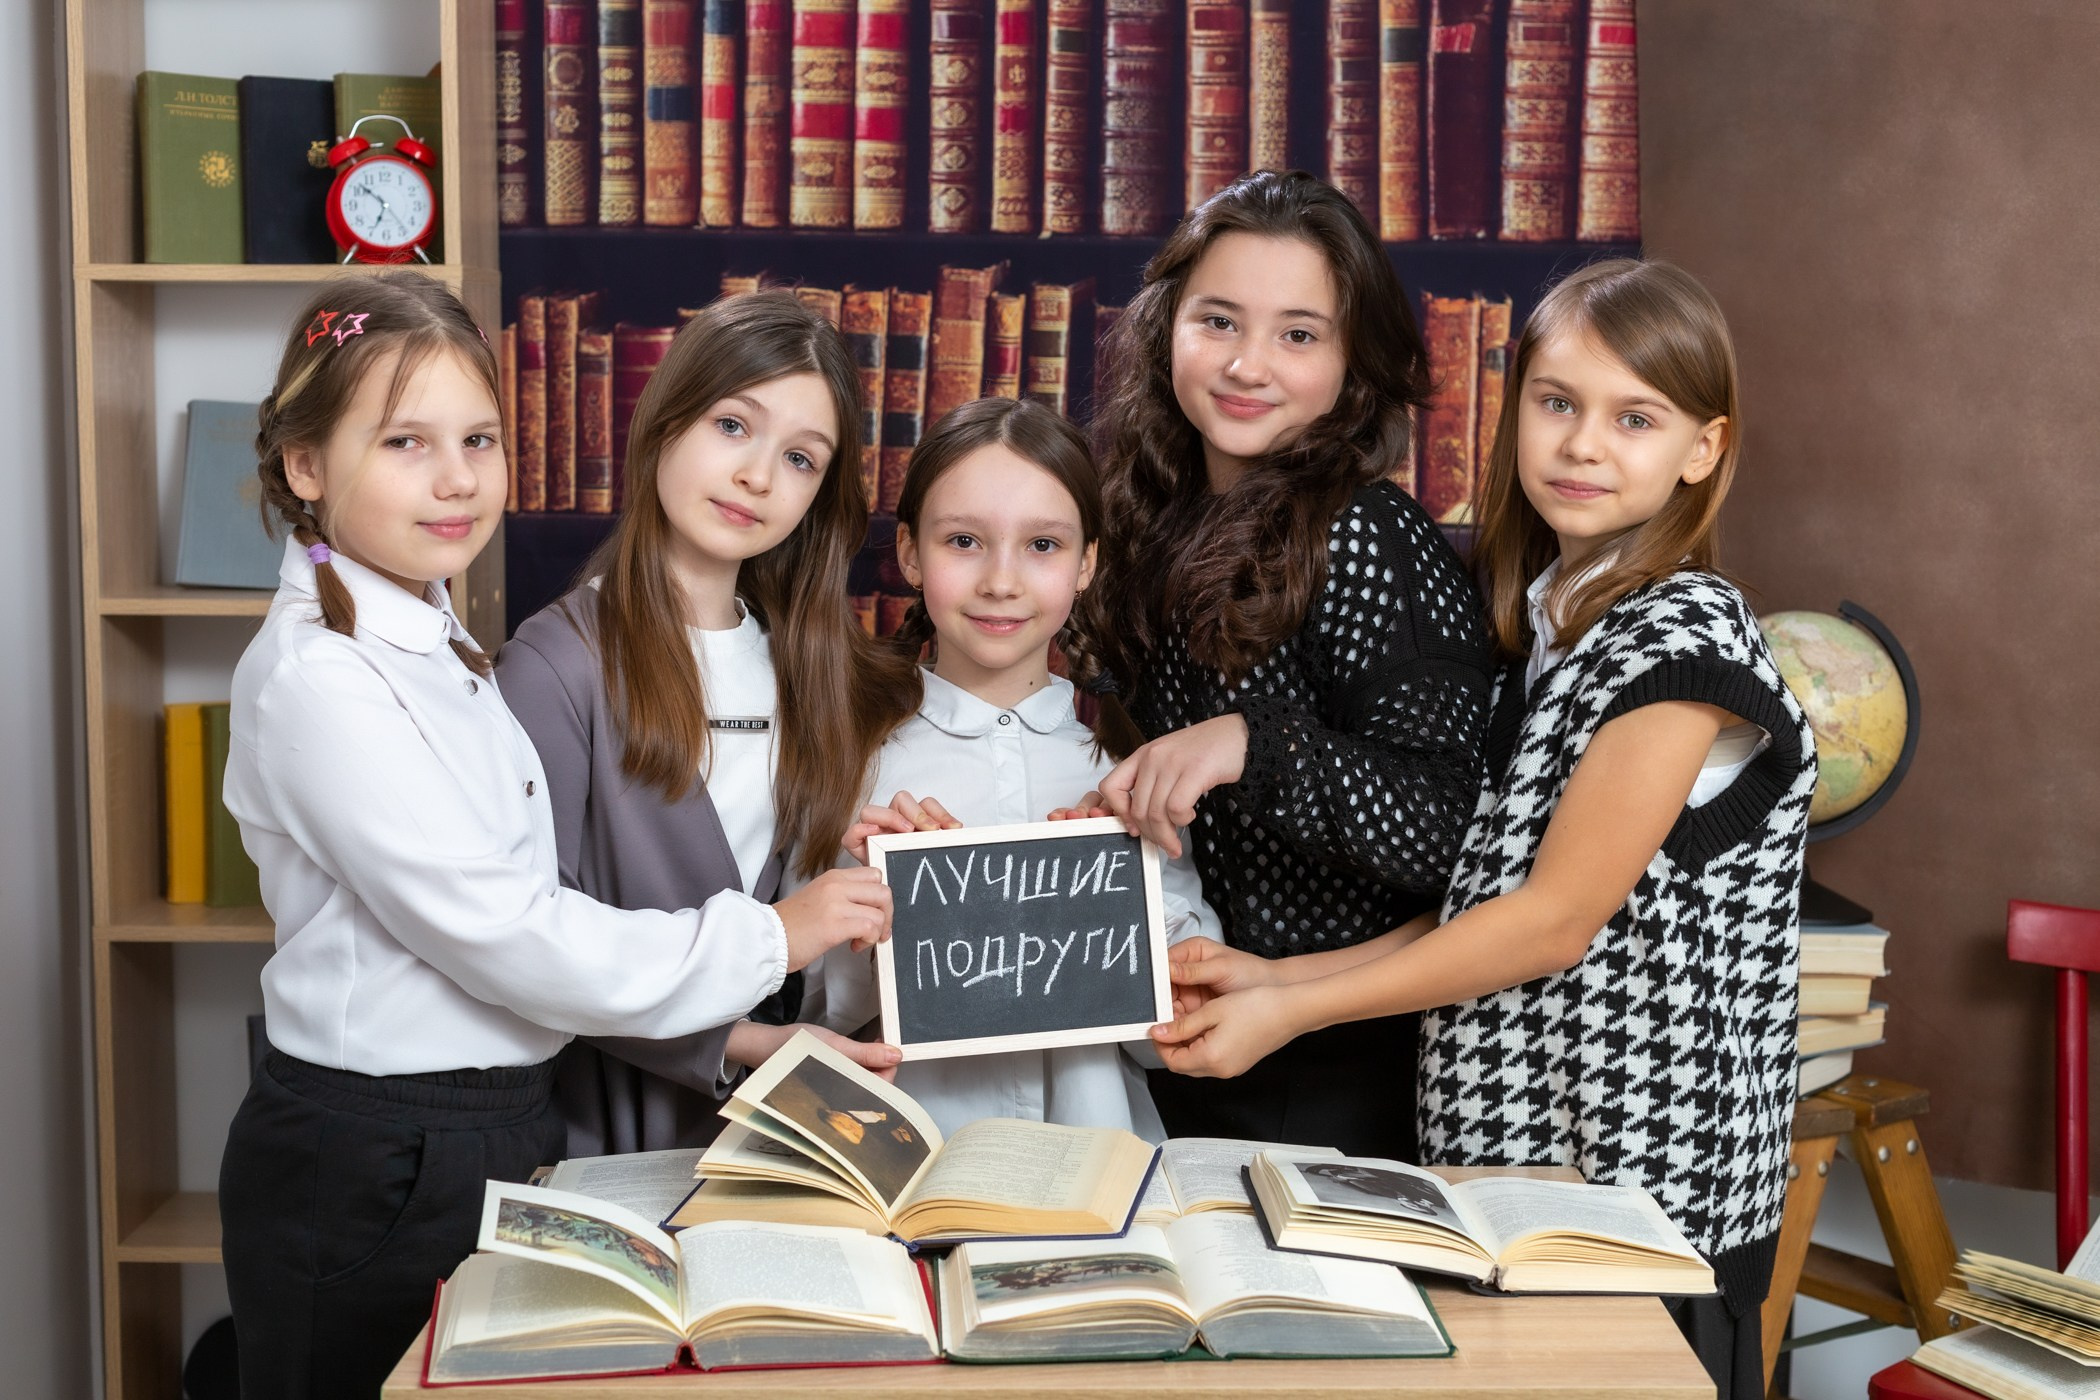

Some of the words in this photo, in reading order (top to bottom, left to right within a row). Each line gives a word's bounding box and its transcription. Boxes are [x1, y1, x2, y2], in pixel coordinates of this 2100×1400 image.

[364, 174, 374, 186] 11
[379, 171, 391, 183] 12
[353, 185, 366, 197] 10
[408, 185, 416, 197] 2
[348, 200, 358, 212] 9
[413, 201, 422, 212] 3
[355, 215, 364, 226] 8
[408, 216, 415, 226] 4
[367, 225, 376, 237] 7
[382, 229, 391, 241] 6
[398, 225, 408, 237] 5
[720, 720, 739, 728] WEAR
[752, 721, 763, 729] BEST
[909, 849, 1131, 906] ЛУЧШИЕ
[916, 923, 1140, 998] ПОДРУГИ
